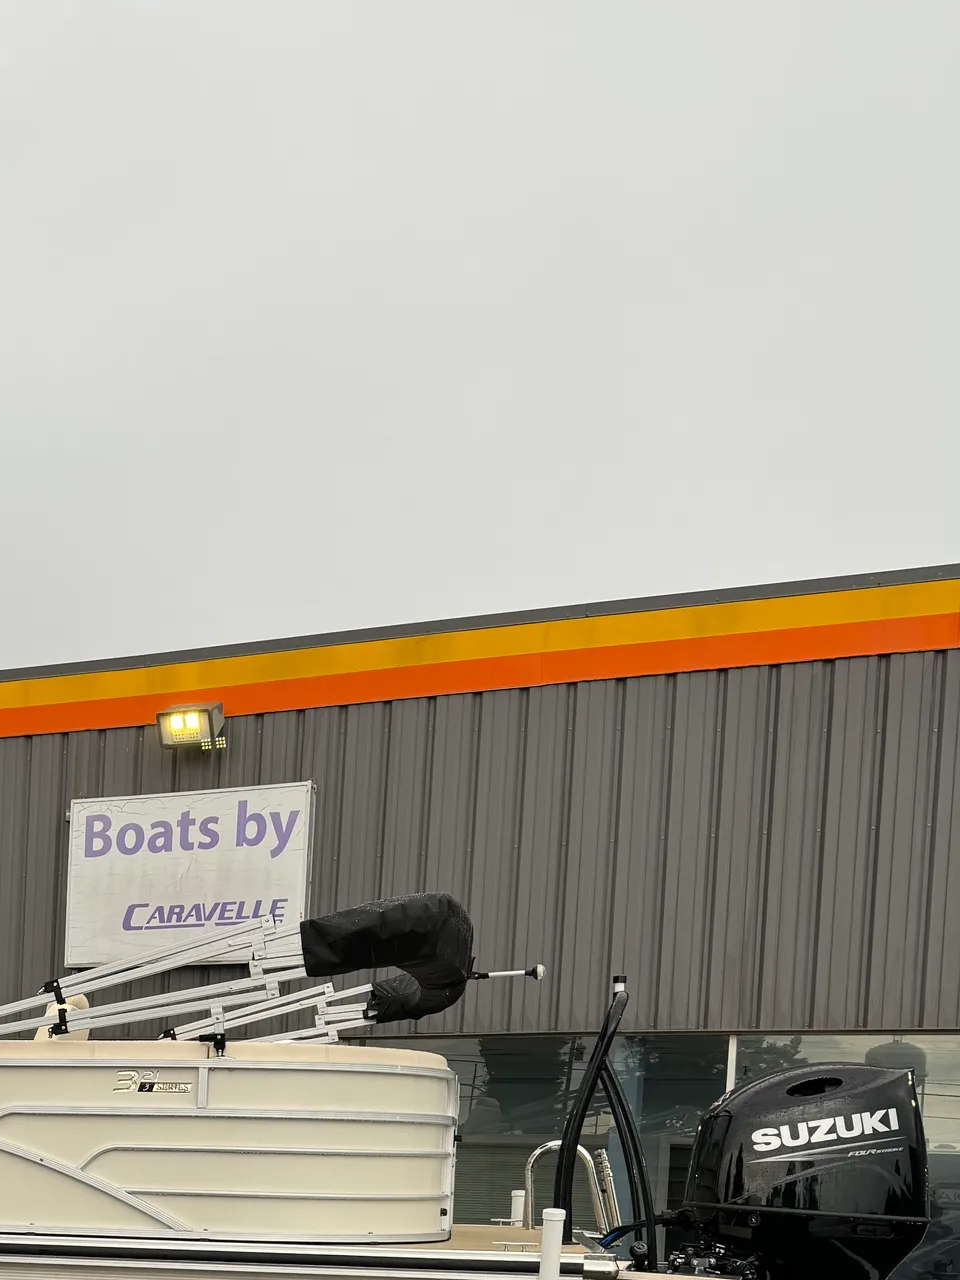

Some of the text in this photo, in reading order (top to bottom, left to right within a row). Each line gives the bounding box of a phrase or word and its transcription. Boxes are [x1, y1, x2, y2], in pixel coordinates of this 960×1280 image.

[84, 800, 301, 858] Boats by
[122, 898, 289, 931] CARAVELLE
[751, 1108, 899, 1152] SUZUKI
